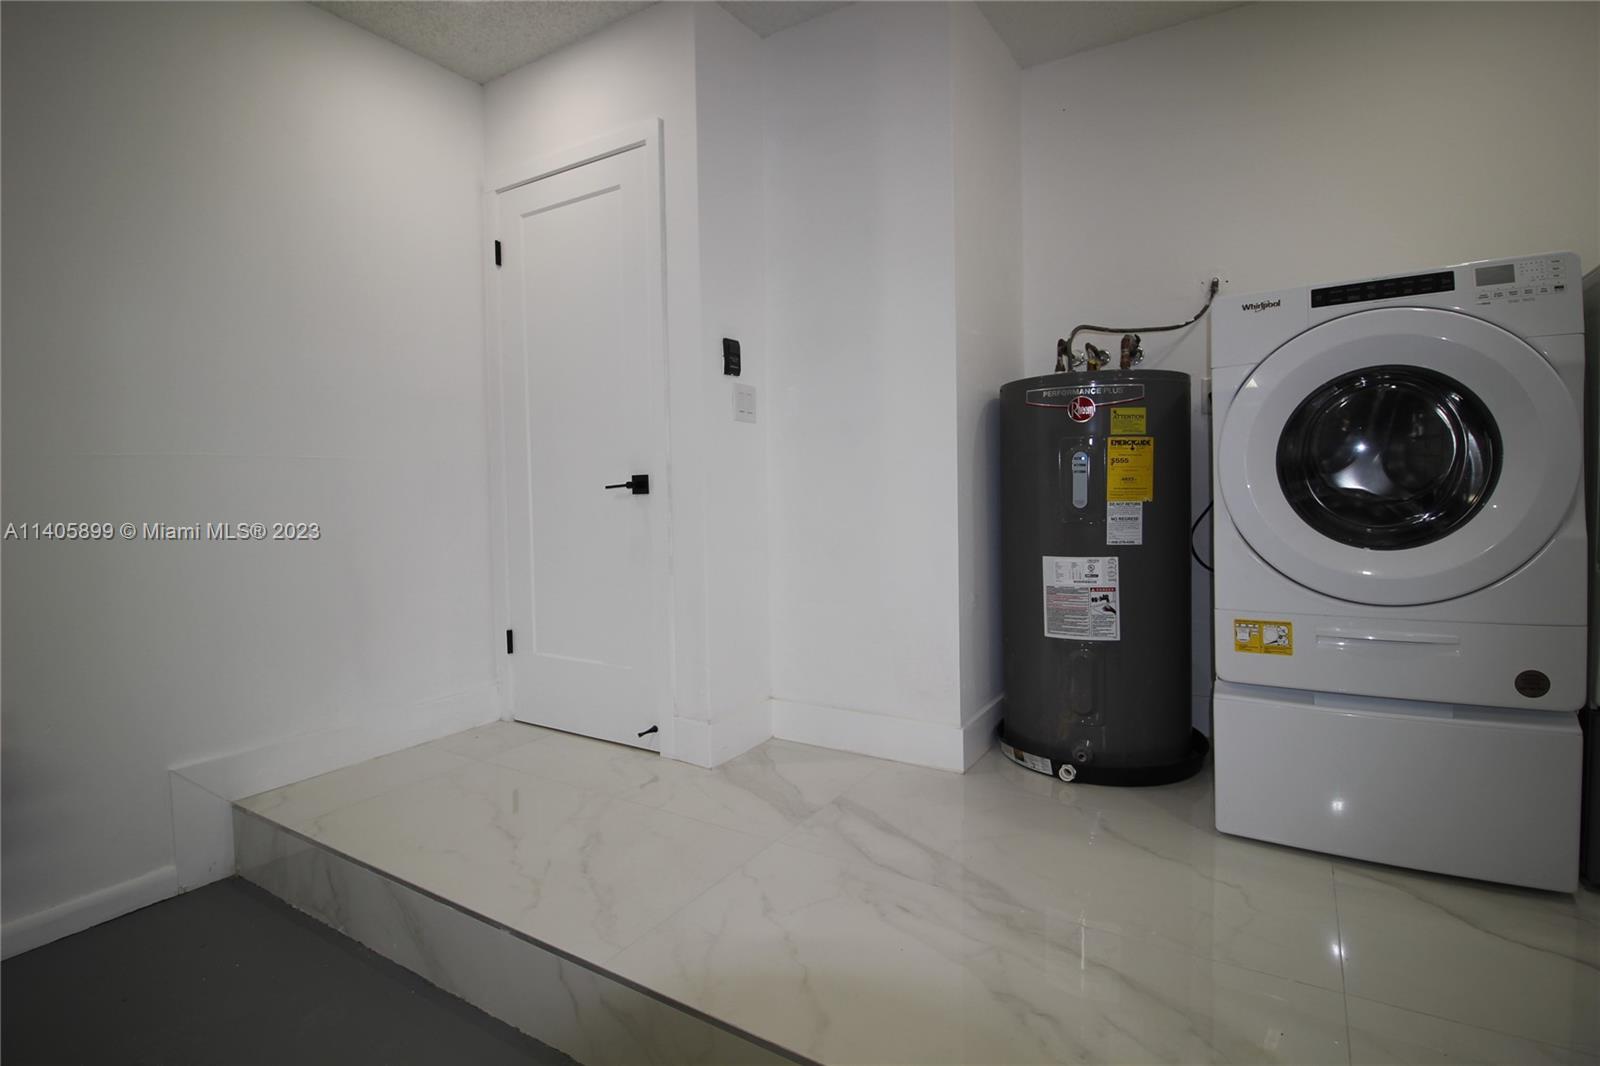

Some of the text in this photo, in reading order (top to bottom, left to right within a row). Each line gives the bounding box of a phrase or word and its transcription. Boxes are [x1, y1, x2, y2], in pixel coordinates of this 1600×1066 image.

[1242, 299, 1281, 312] Whirlpool
[1042, 386, 1124, 398] PERFORMANCE PLUS
[1071, 397, 1096, 418] Rheem
